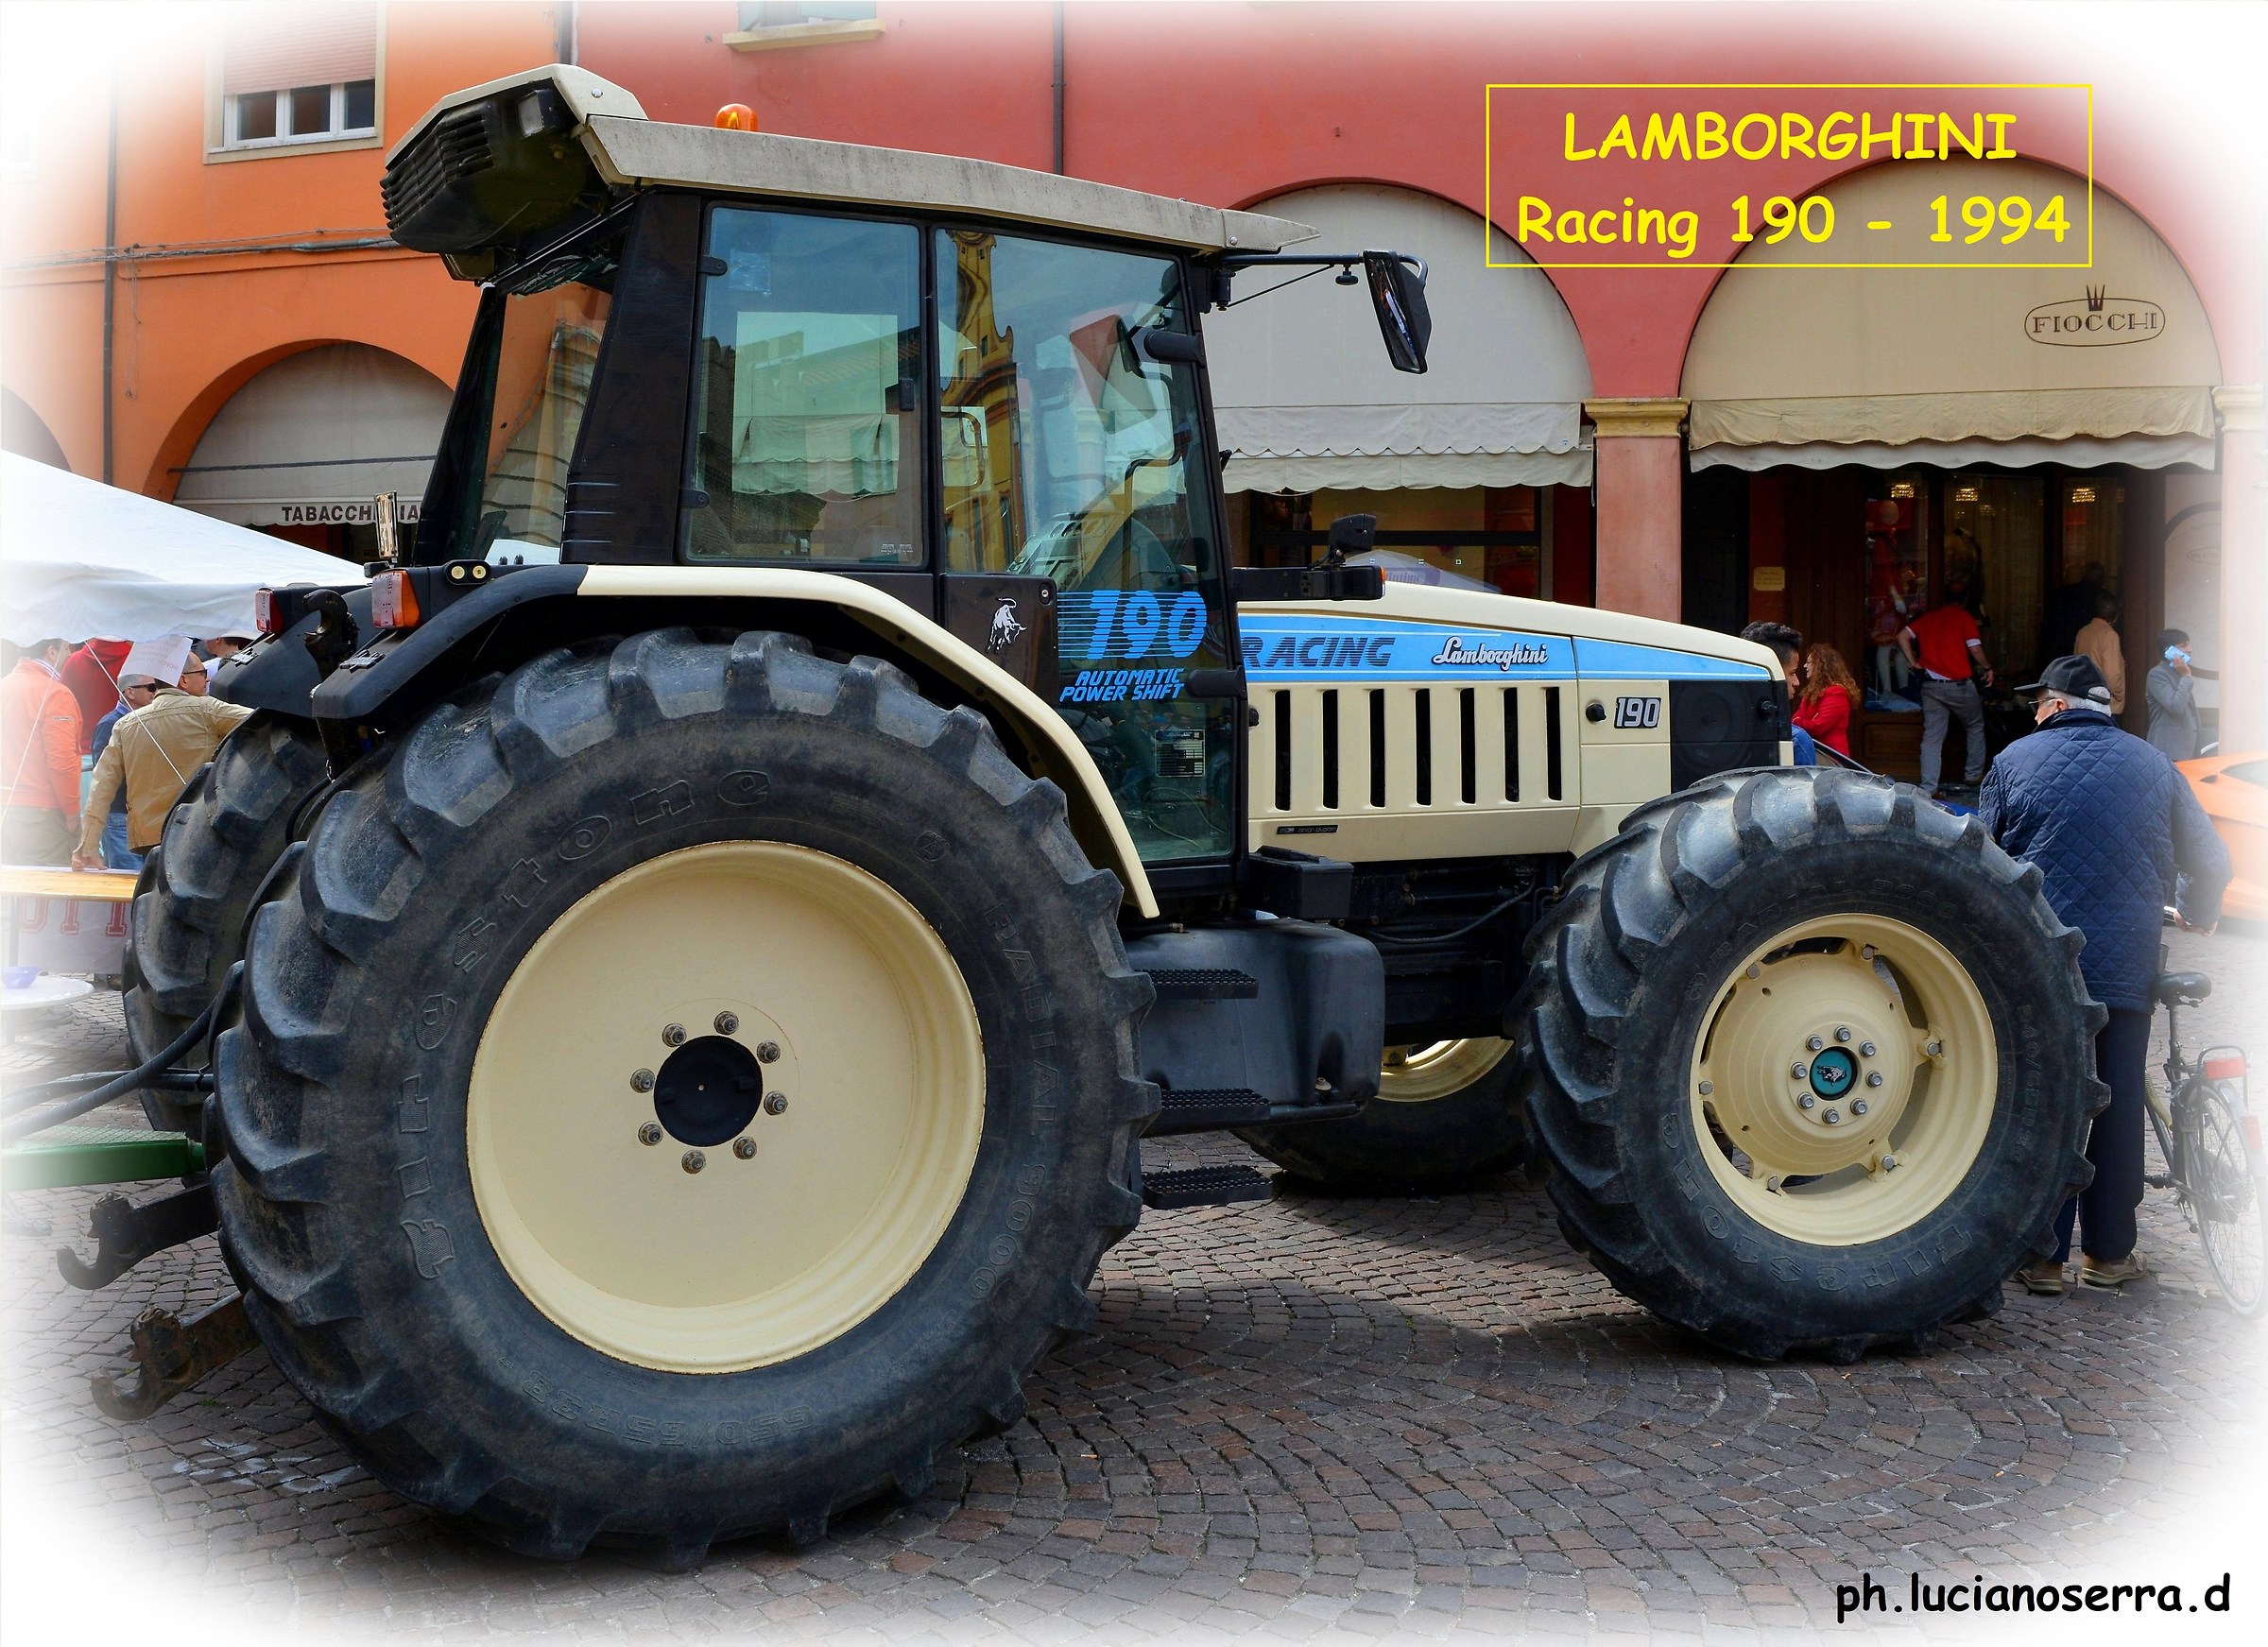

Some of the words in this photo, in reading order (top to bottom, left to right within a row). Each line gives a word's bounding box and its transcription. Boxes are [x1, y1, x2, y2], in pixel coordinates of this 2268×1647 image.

[2032, 312, 2157, 334] FIOCCHI
[282, 505, 419, 522] TABACCHIA
[1087, 590, 1208, 660] 190
[1240, 636, 1397, 667] RACING
[1431, 634, 1550, 672] Lamborghini
[1074, 667, 1185, 688] AUTOMATIC
[1058, 686, 1128, 703] POWER
[1131, 682, 1186, 702] SHIFT
[1615, 696, 1661, 728] 190
